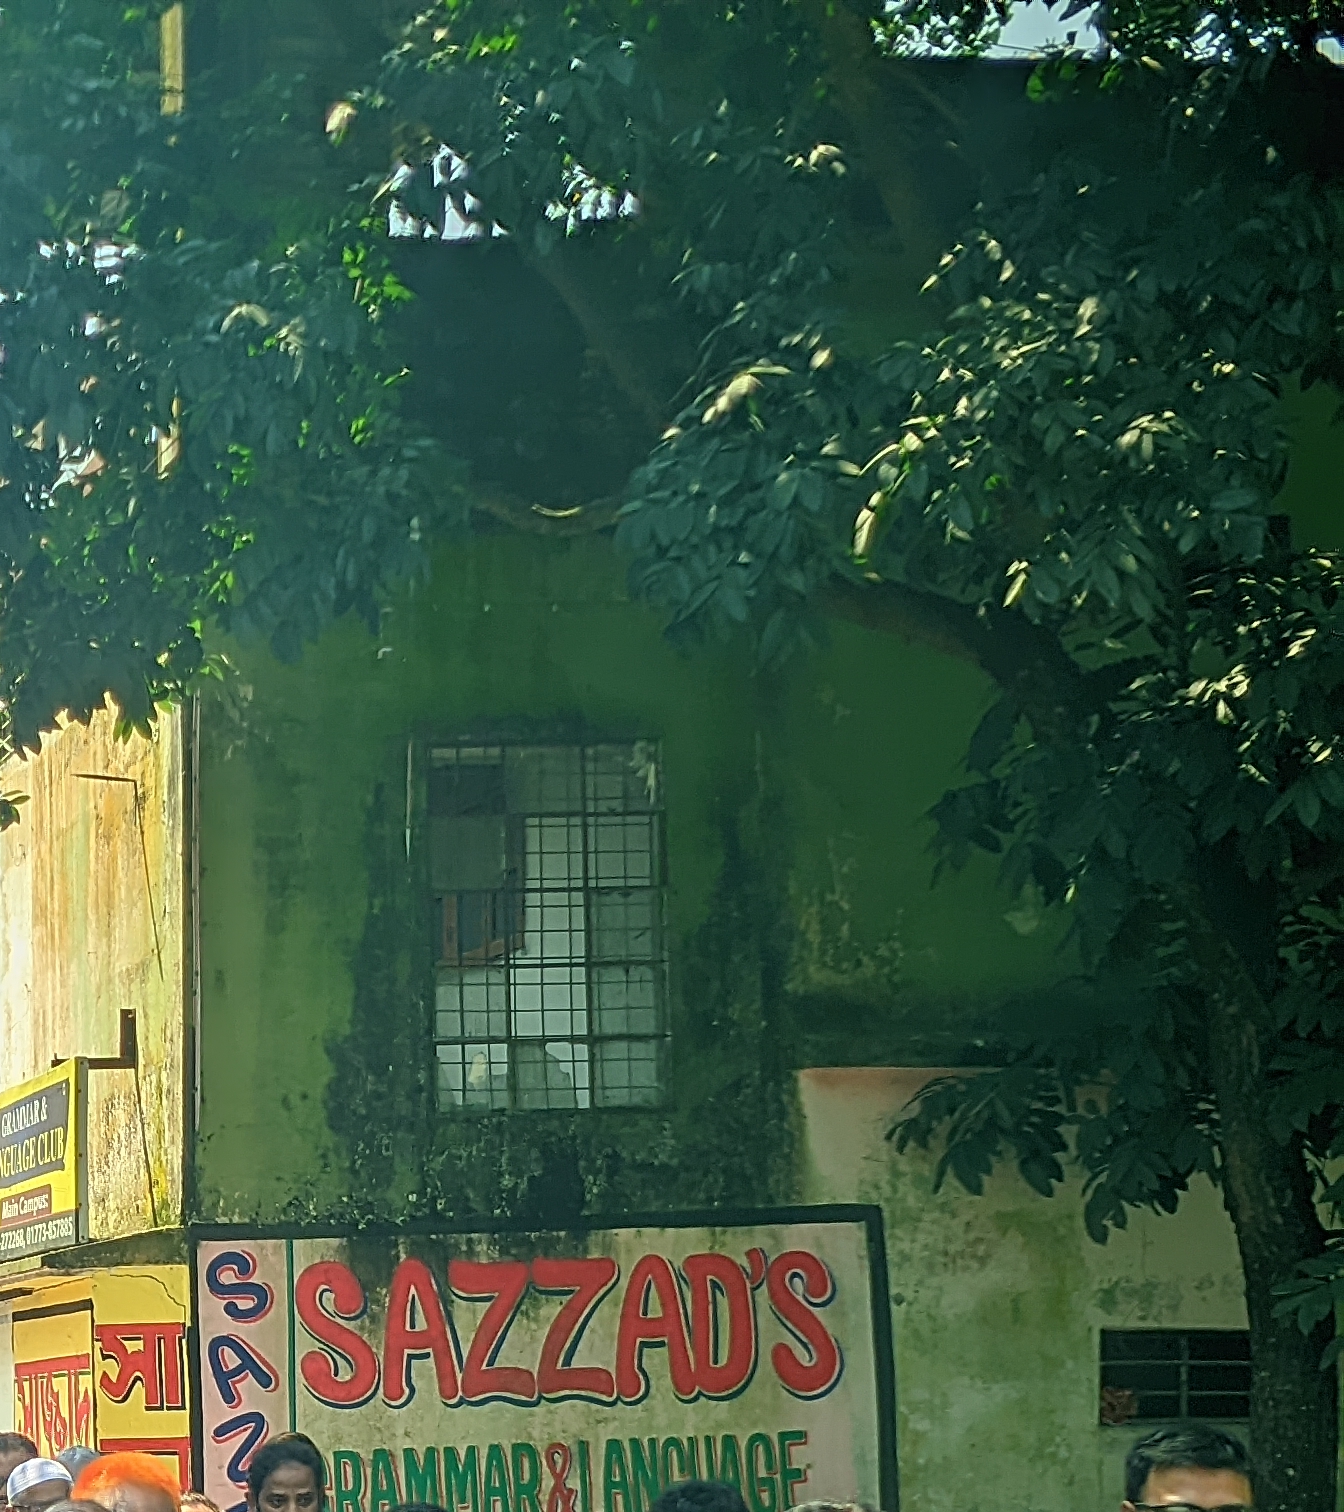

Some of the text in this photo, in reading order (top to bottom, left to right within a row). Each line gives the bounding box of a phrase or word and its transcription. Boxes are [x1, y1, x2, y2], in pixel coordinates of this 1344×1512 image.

[1, 1099, 40, 1138] GRAMMAR
[38, 1126, 65, 1166] CLUB
[2, 1197, 19, 1220] Main
[295, 1248, 844, 1410] SAZZAD'S
